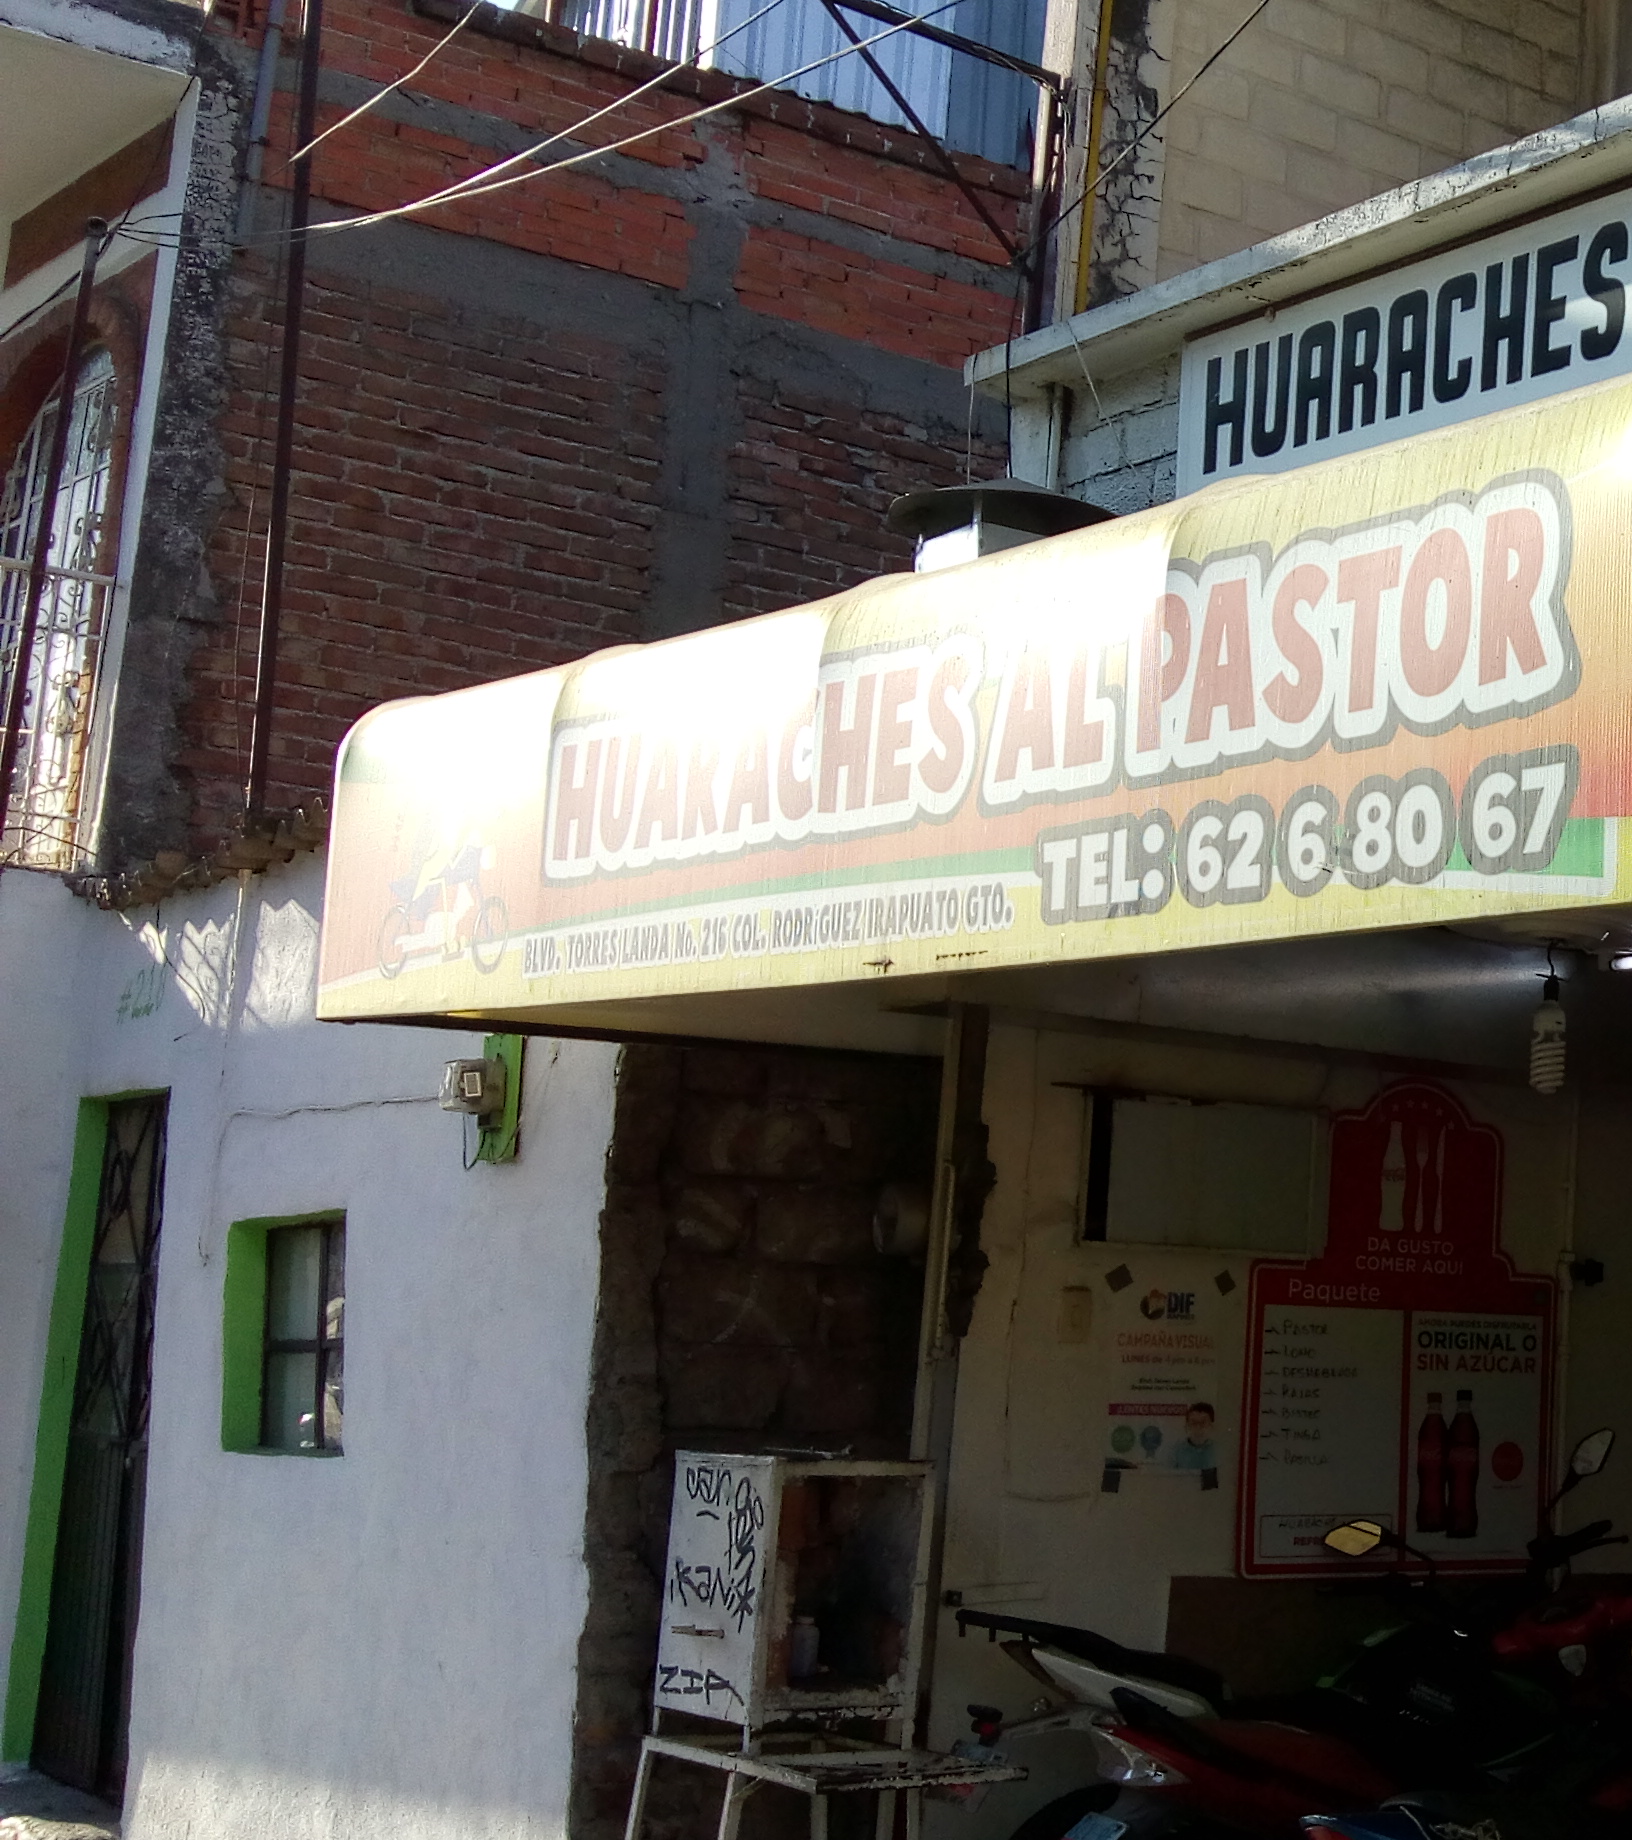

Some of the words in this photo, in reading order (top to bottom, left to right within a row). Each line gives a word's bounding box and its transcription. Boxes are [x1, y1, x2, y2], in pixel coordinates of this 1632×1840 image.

[1204, 220, 1628, 475] HUARACHES
[551, 648, 968, 862] HUARACHES
[993, 636, 1105, 785] AL
[1135, 505, 1548, 755] PASTOR
[1043, 822, 1167, 912] TEL:
[1186, 808, 1262, 892] 62
[1286, 804, 1328, 882] 6
[1350, 783, 1445, 874] 80
[1470, 760, 1568, 860] 67
[523, 937, 561, 975] BLVD.
[566, 931, 619, 970] TORRES
[619, 925, 670, 965] LANDA
[702, 918, 728, 955] 216
[731, 912, 767, 953] COL.
[865, 891, 959, 939] IRAPUATO
[964, 884, 1013, 929] GTO.
[1367, 1236, 1391, 1252] DA
[1396, 1239, 1454, 1256] GUSTO
[1355, 1255, 1417, 1273] COMER
[1167, 1292, 1195, 1313] DIF
[1288, 1277, 1382, 1304] Paquete
[1417, 1331, 1516, 1352] ORIGINAL
[1522, 1334, 1537, 1352] O
[1417, 1353, 1449, 1371] SIN
[1455, 1350, 1537, 1373] AZÚCAR
